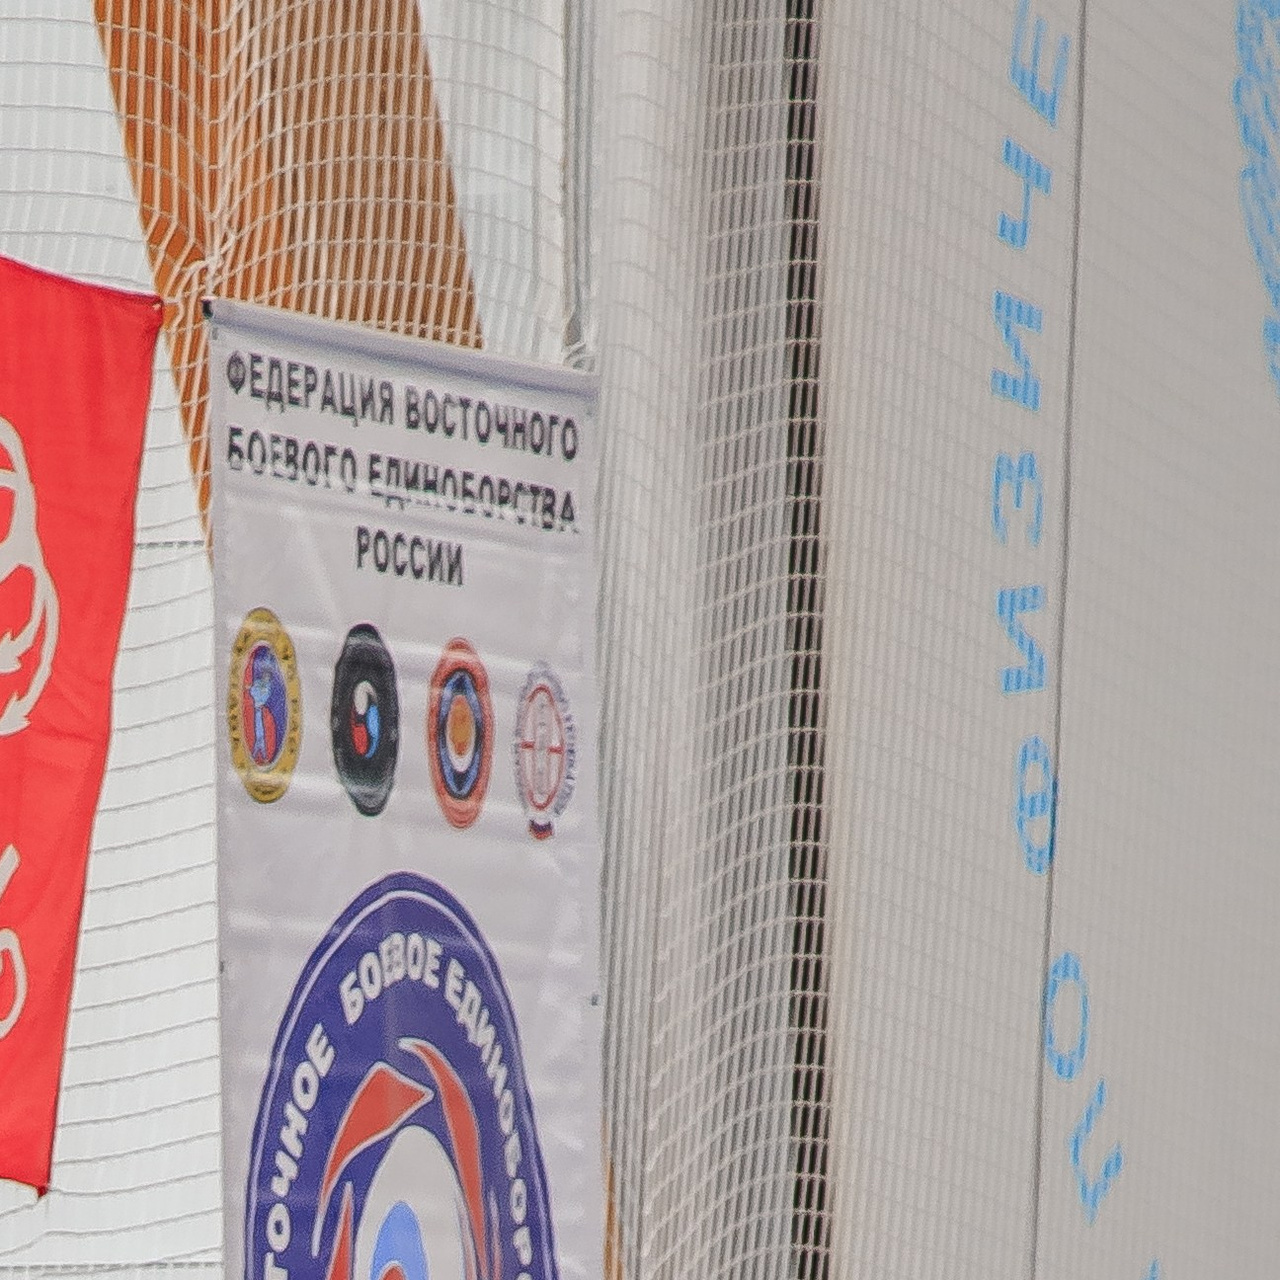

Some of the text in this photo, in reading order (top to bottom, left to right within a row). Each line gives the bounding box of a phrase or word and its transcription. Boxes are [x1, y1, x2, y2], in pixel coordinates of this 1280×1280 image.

[225, 351, 578, 461] ФЕДЕРАЦИЯ ВОСТОЧНОГО
[226, 425, 358, 493] БОЕВОГО
[356, 526, 464, 587] РОССИИ
